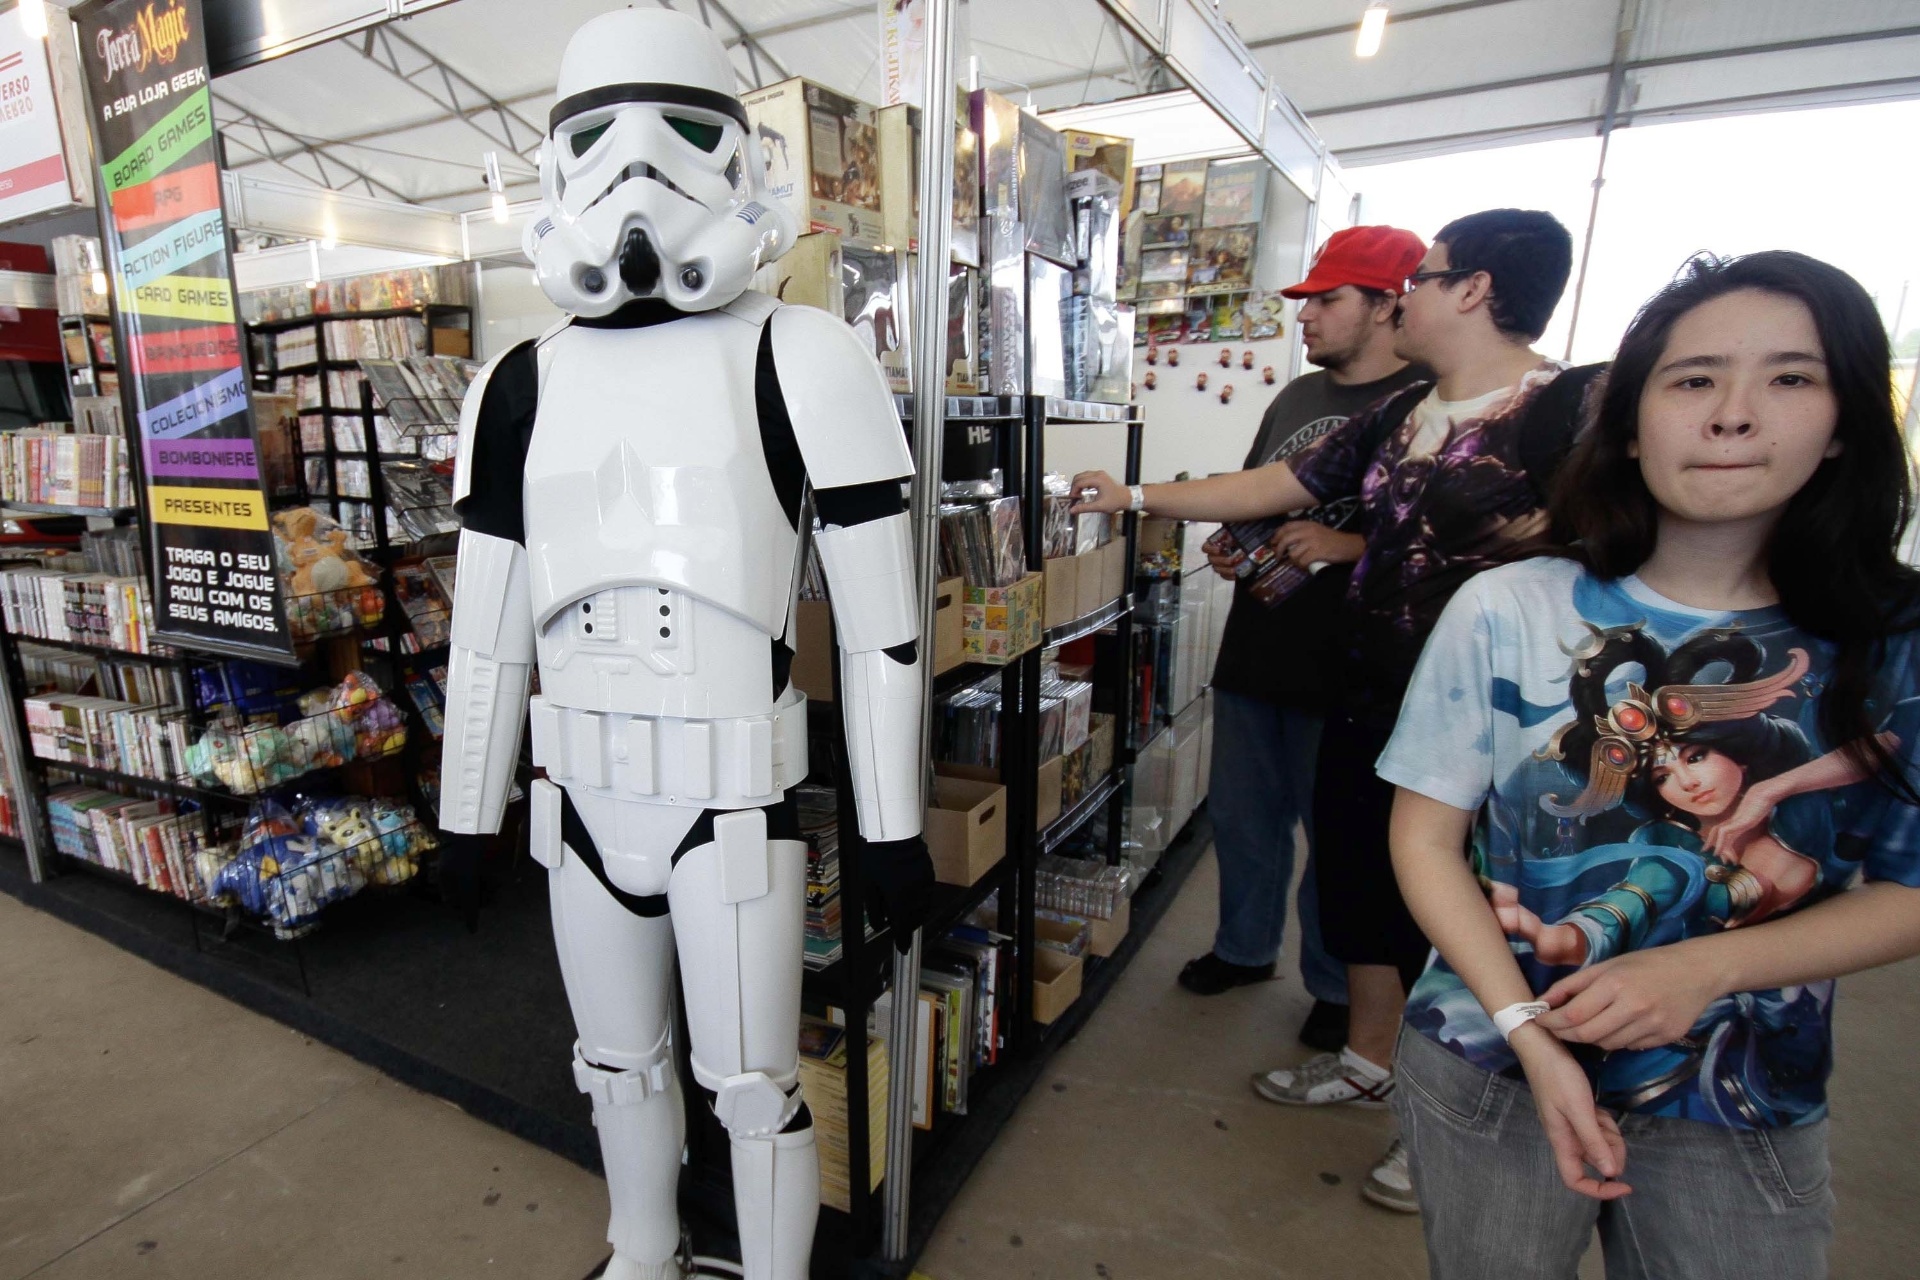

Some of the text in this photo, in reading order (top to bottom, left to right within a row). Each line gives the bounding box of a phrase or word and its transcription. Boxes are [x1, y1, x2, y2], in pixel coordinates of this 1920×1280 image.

[97, 25, 141, 83] Terra
[0, 75, 30, 101] ERSO
[103, 66, 206, 121] A SUA LOJA GEEK
[113, 104, 206, 188] BOARD GAMES
[154, 186, 183, 206] RPG
[124, 244, 171, 281] ACTION
[136, 286, 230, 307] CARD GAMES
[159, 450, 255, 467] BOMBONIERE
[164, 498, 252, 517] PRESENTES
[165, 546, 271, 571] TRAGA O SEU
[165, 565, 275, 592] JOGO E JOGUE
[170, 585, 273, 612] AQUI COM OS
[168, 603, 279, 633] SEUS AMIGOS.
